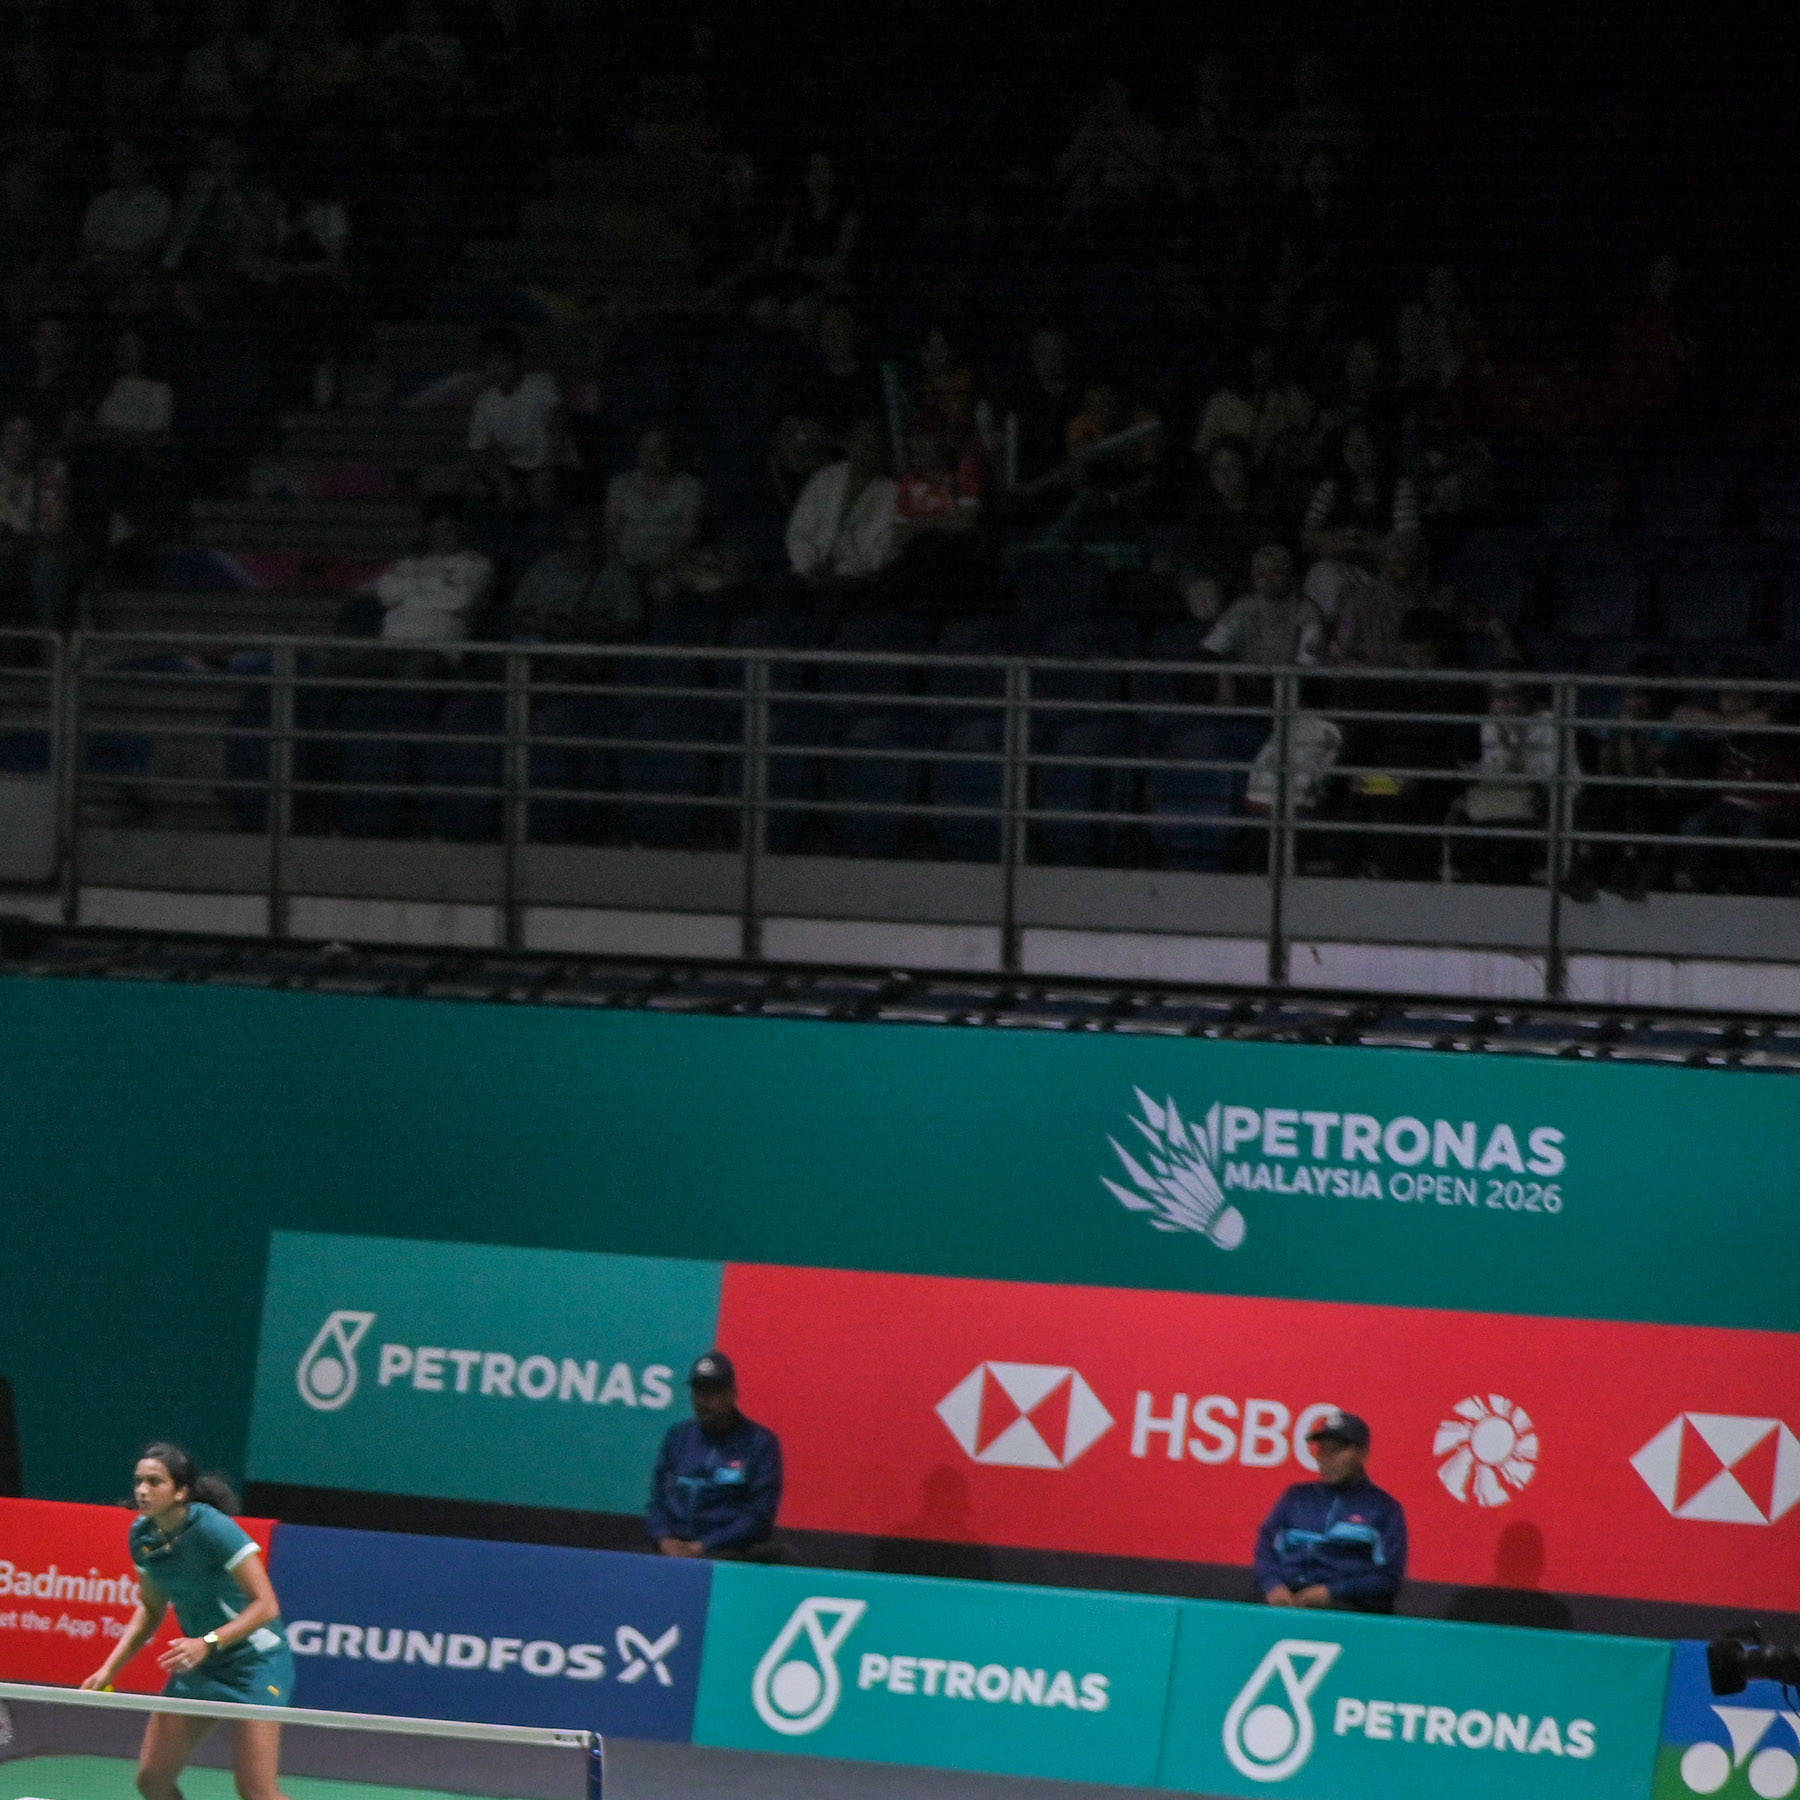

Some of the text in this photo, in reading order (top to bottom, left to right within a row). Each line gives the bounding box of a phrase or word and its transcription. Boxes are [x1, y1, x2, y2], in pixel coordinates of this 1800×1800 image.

[1222, 1104, 1567, 1178] PETRONAS
[1223, 1161, 1563, 1215] MALAYSIA OPEN 2026
[377, 1343, 674, 1410] PETRONAS
[21, 1609, 51, 1633] the
[53, 1613, 96, 1640] App
[285, 1620, 607, 1681] GRUNDFOS
[857, 1652, 1111, 1715] PETRONAS
[1332, 1696, 1597, 1761] PETRONAS
